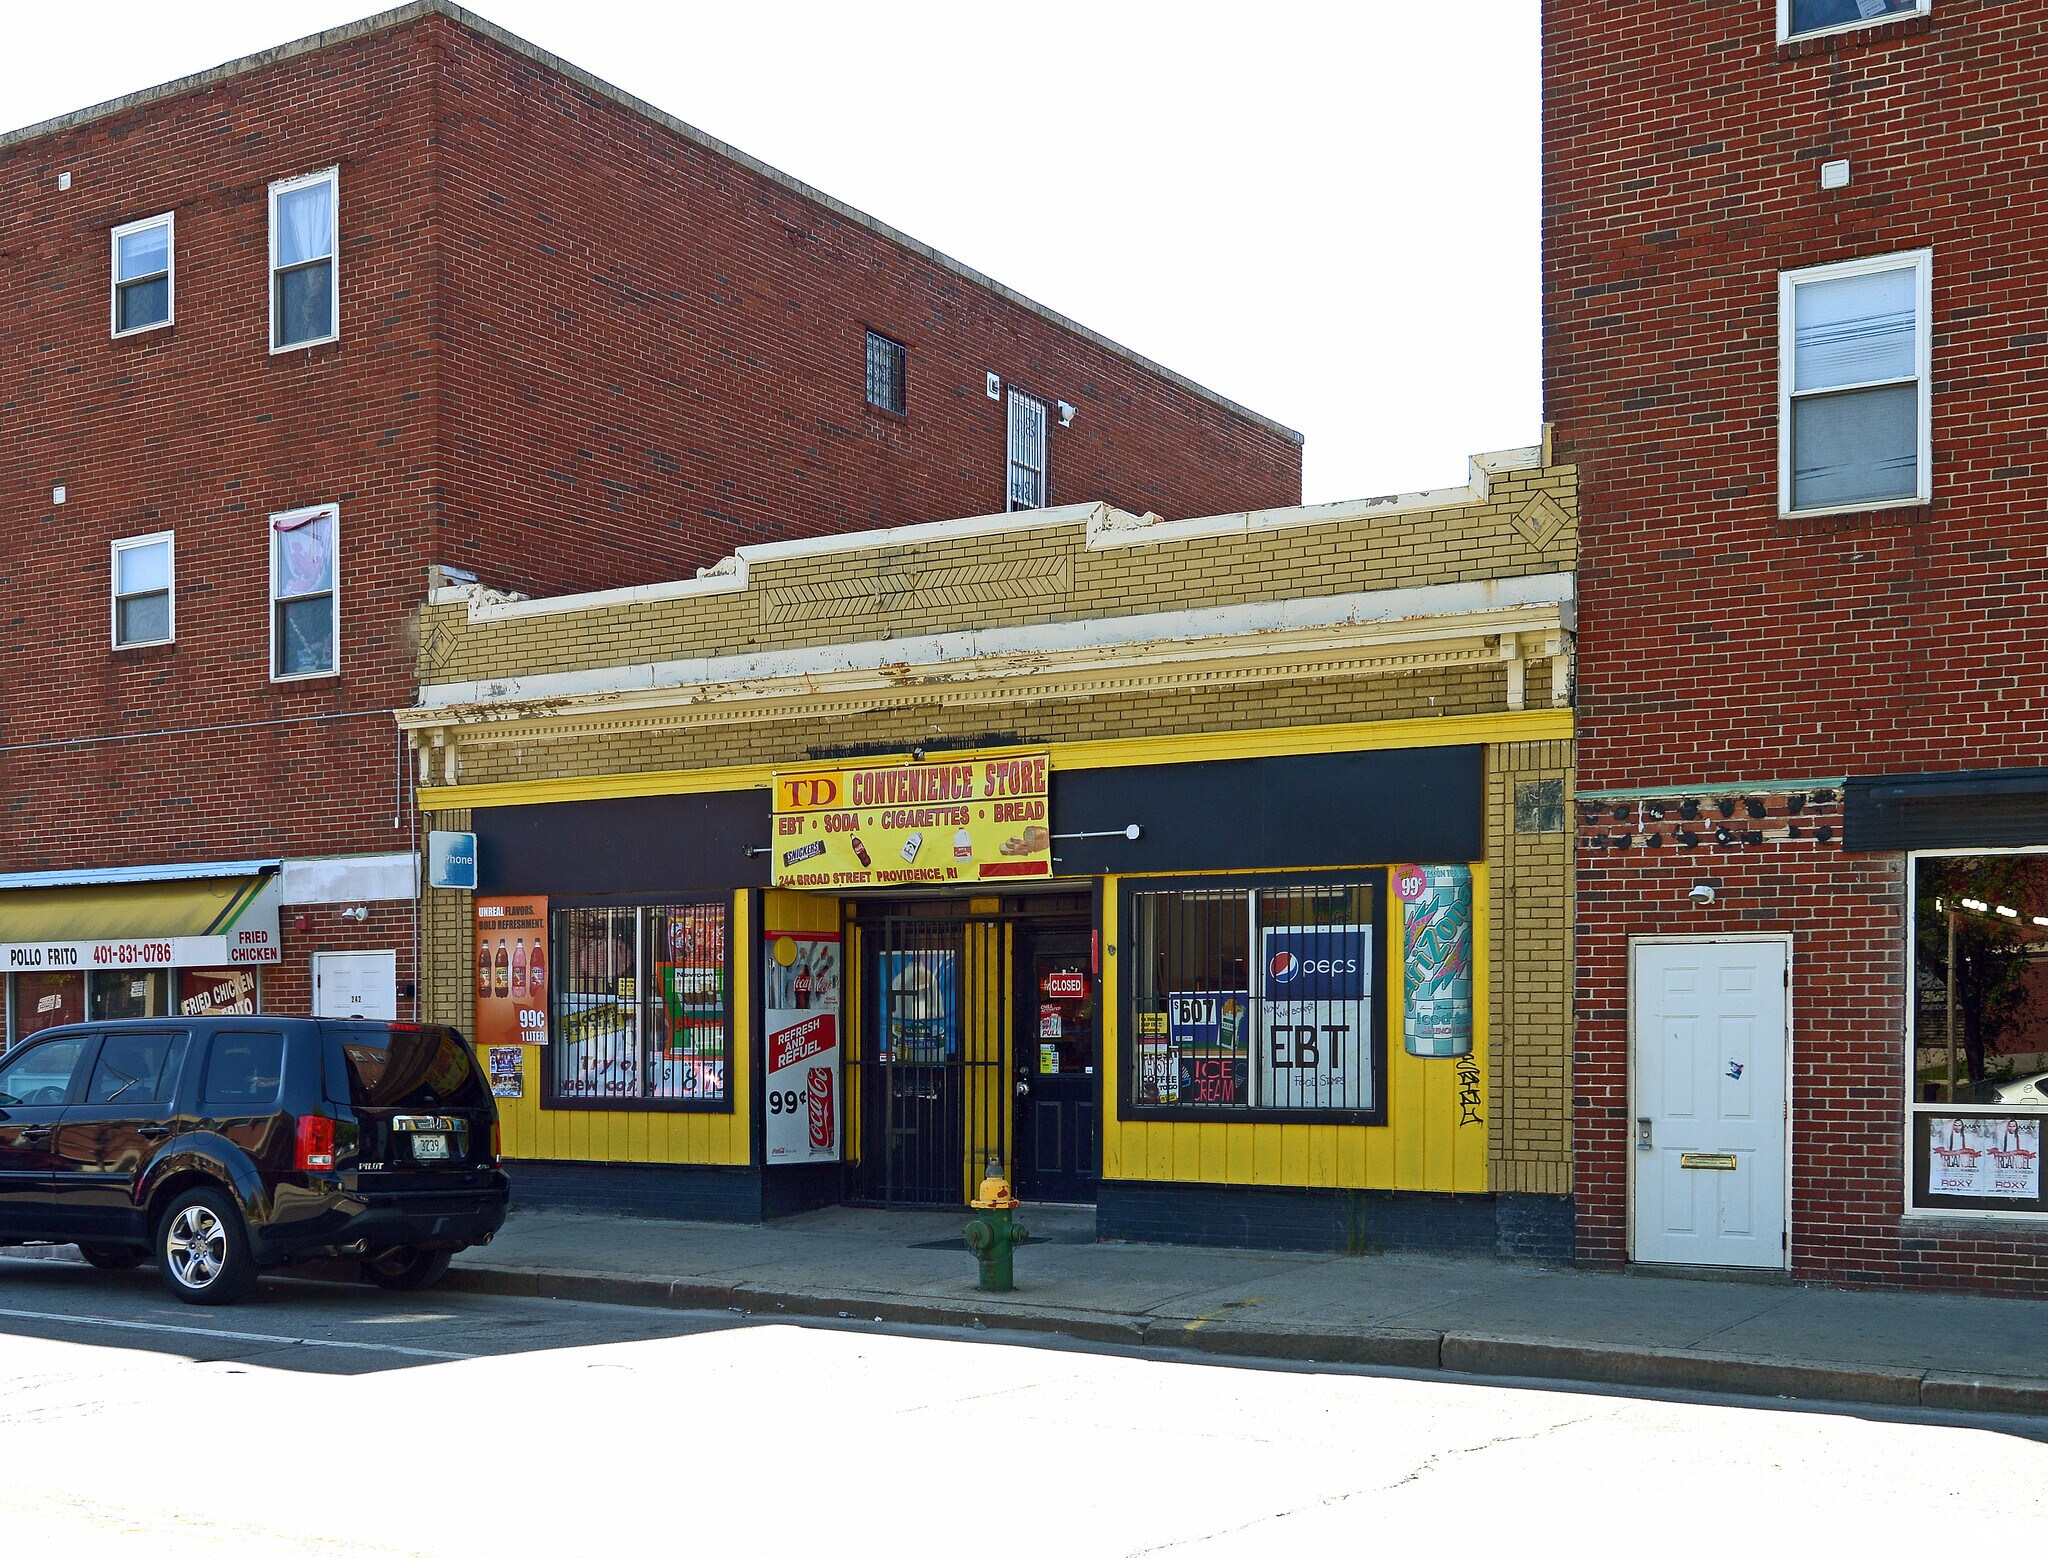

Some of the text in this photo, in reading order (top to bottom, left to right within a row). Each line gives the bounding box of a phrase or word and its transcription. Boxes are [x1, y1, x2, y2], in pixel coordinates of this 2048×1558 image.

[784, 758, 1046, 807] TD CONVENIENCE STORE
[779, 801, 1045, 835] EBT SODA CIGARETTES BREAD
[779, 867, 958, 887] 244 BROAD STREET PROVIDENCE, RI
[478, 905, 535, 918] UNREAL FLAVORS.
[479, 917, 544, 930] BOLD REFRESHMENT.
[239, 930, 268, 944] FRIED
[11, 943, 171, 966] POLLO FRITO 401-831-0786
[231, 947, 278, 962] CHICKEN
[184, 971, 255, 1015] FRIED CHICKEN
[1051, 980, 1081, 991] CLOSED
[520, 1009, 544, 1028] 99¢
[525, 1030, 545, 1042] LITER
[778, 1019, 820, 1045] REFRESH
[785, 1036, 805, 1052] AND
[1270, 1025, 1350, 1068] EBT
[778, 1040, 821, 1068] REFUEL
[1195, 1061, 1232, 1078] ICE
[769, 1090, 807, 1115] 99¢
[420, 1139, 439, 1152] 3239
[359, 1162, 384, 1170] PILOT
[1996, 1181, 2027, 1189] ROXY
